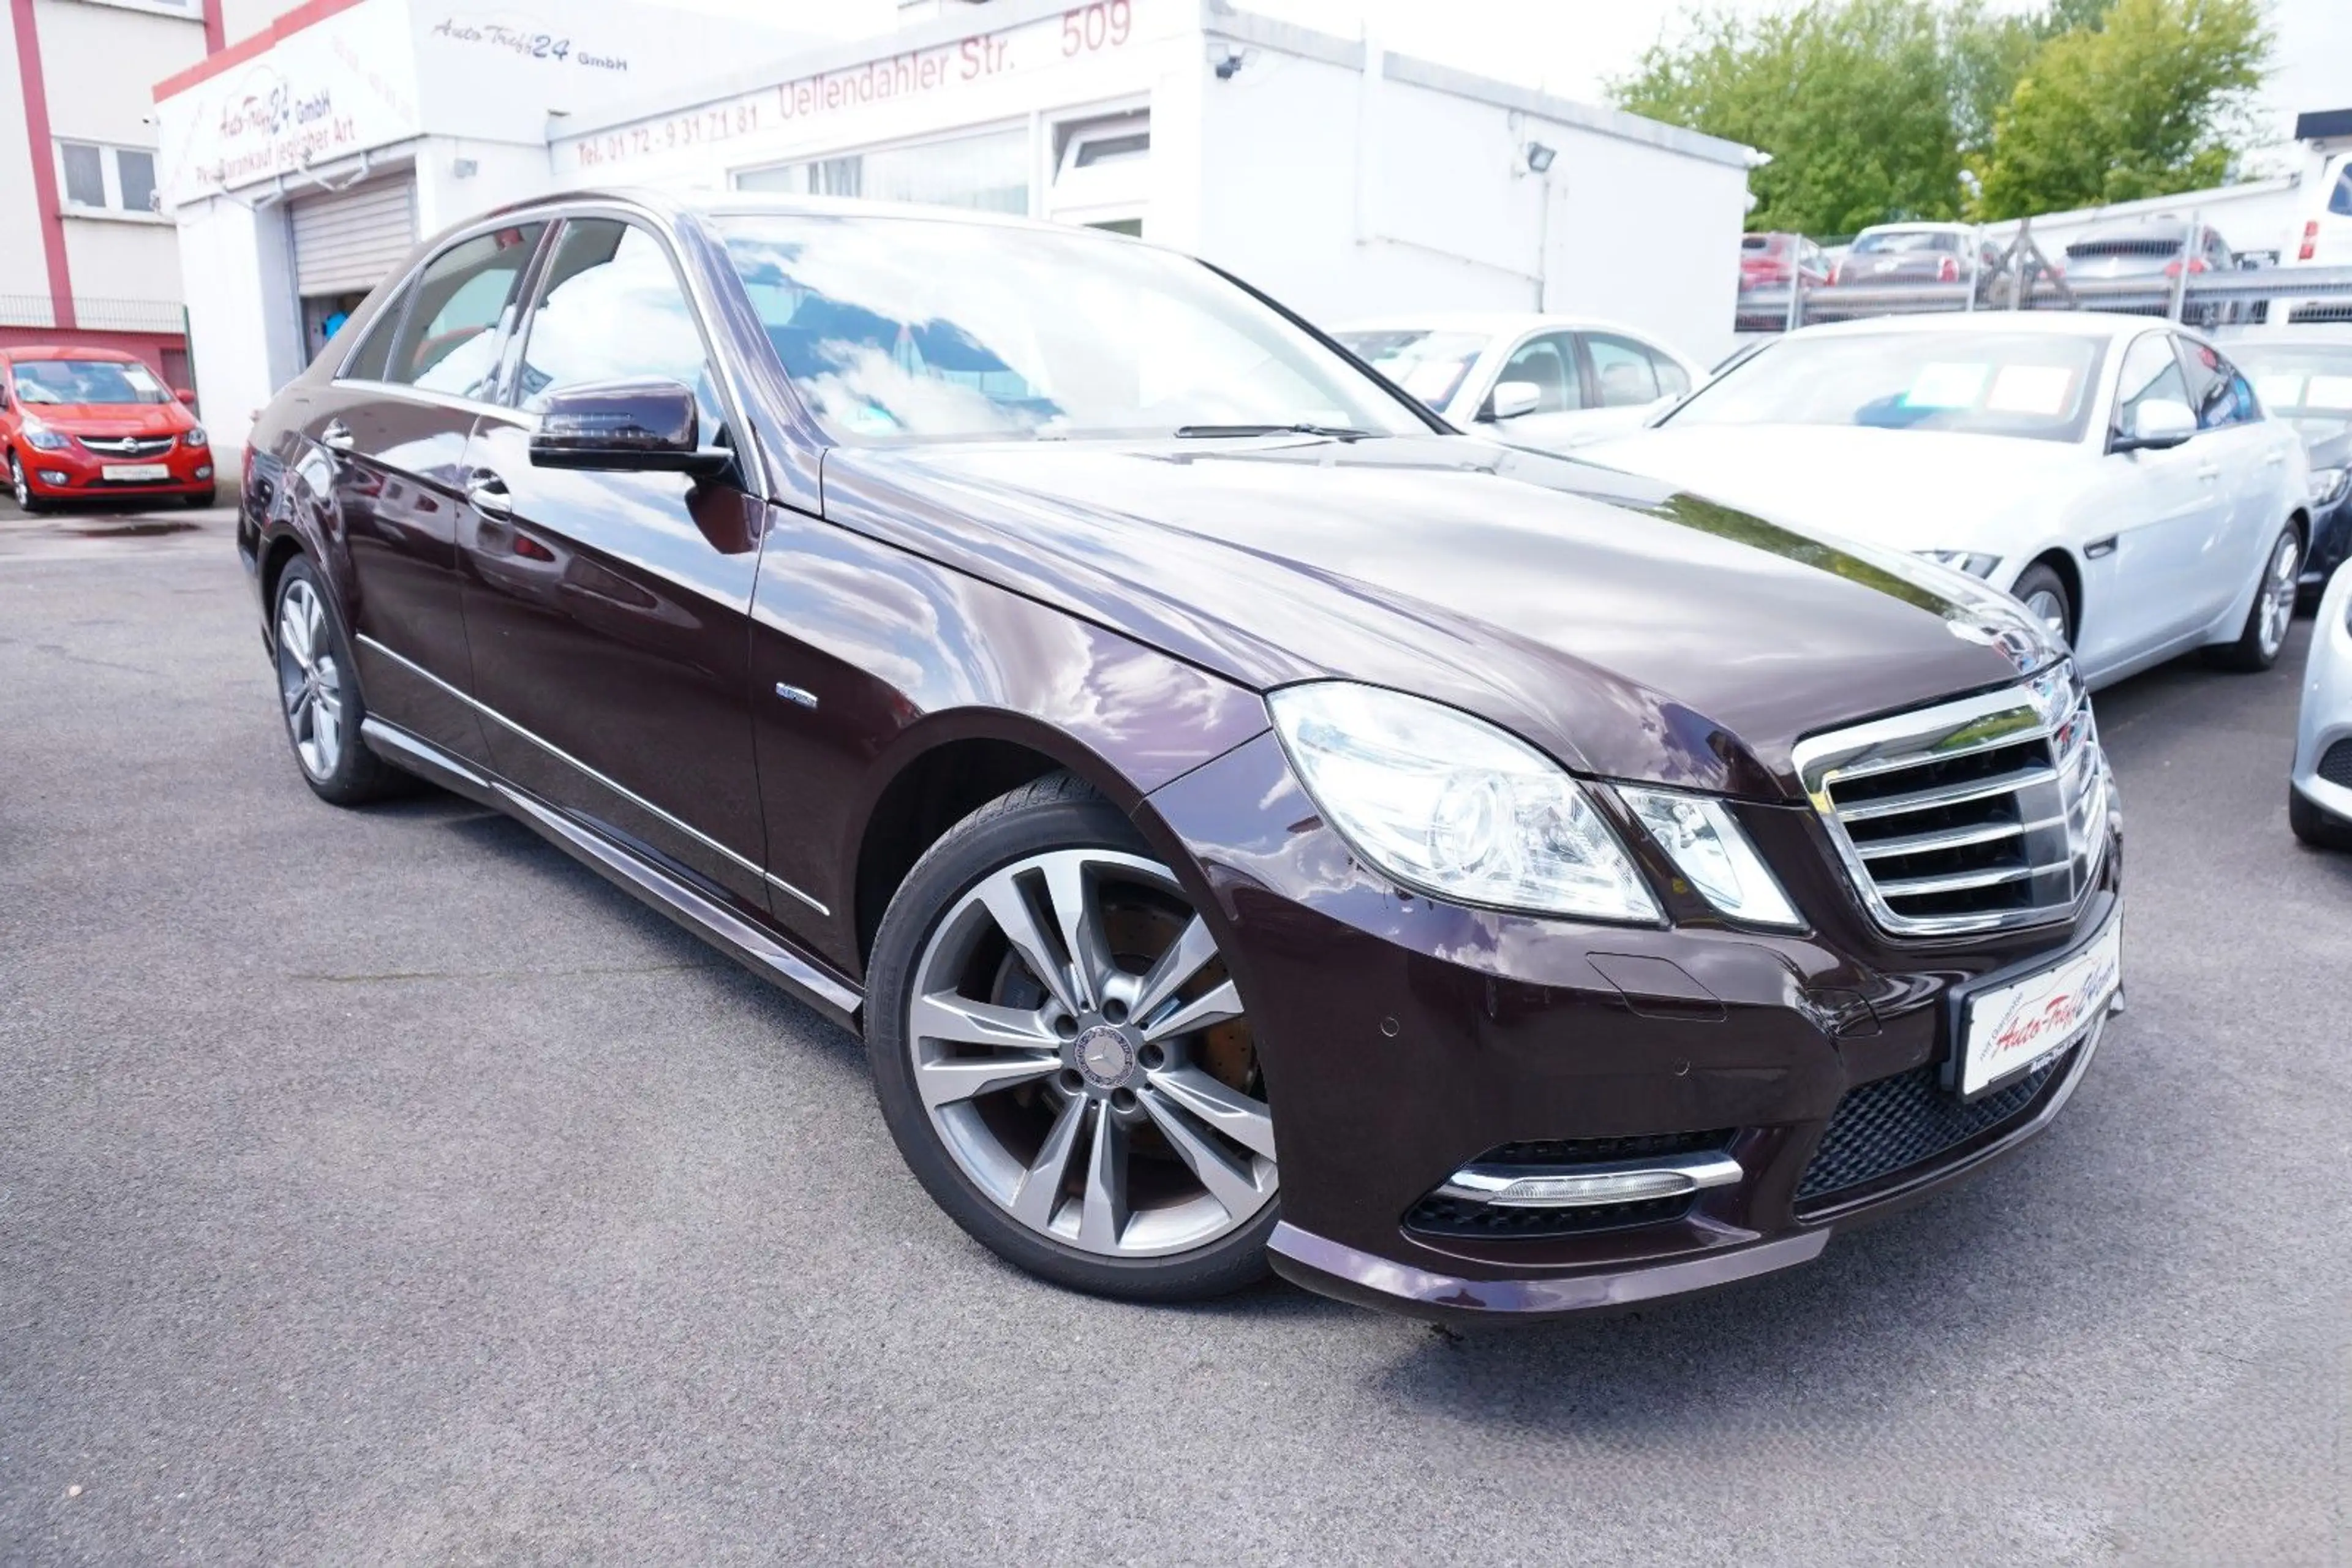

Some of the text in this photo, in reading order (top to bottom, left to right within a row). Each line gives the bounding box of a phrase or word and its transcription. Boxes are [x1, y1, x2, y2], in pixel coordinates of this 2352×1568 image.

[576, 51, 628, 72] GmbH
[778, 0, 1131, 120] Uellendahler Str. 509
[295, 86, 332, 125] GmbH
[333, 112, 355, 143] Art
[576, 135, 604, 166] Tel.
